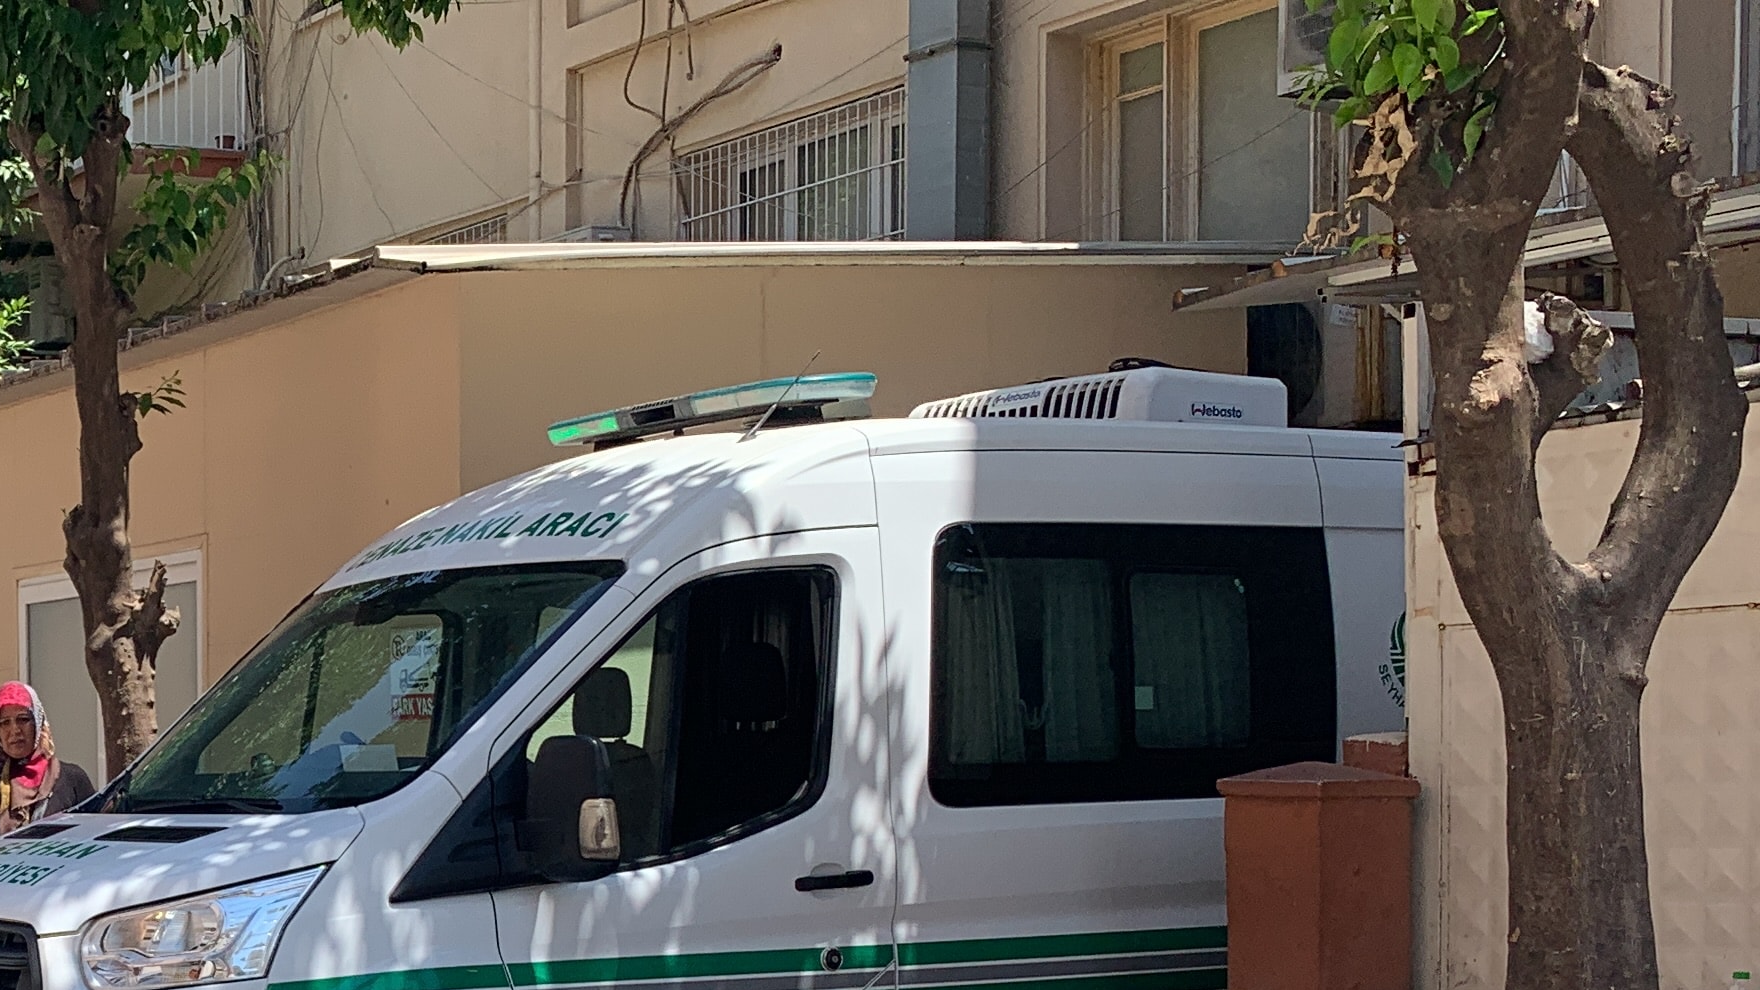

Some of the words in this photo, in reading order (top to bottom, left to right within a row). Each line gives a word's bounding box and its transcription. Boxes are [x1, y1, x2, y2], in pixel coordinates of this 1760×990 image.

[1191, 403, 1243, 419] Webasto
[431, 511, 524, 547] NAKİL
[516, 512, 630, 538] ARACI
